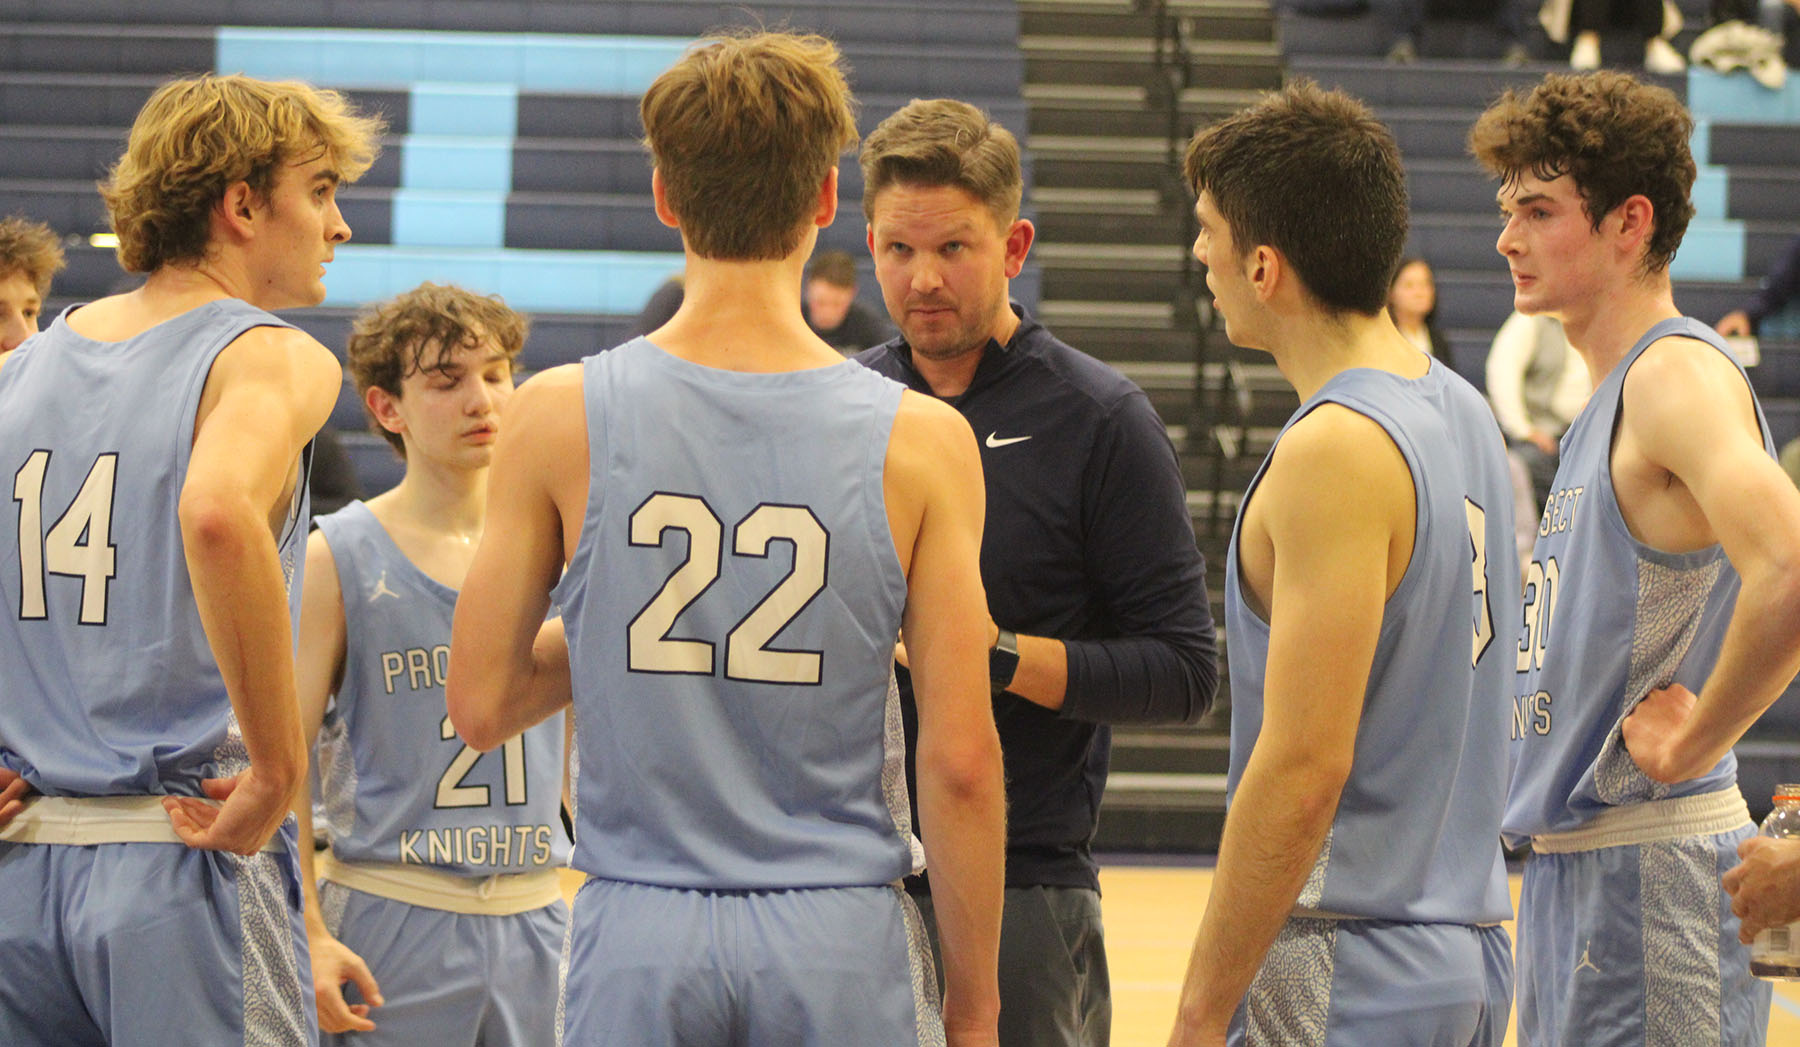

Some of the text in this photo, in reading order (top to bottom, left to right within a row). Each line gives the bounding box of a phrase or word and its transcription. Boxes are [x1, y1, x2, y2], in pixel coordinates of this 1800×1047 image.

[13, 449, 119, 626] 14
[627, 491, 830, 686] 22
[1516, 556, 1560, 674] 30
[433, 712, 528, 809] 21
[400, 825, 552, 866] KNIGHTS
